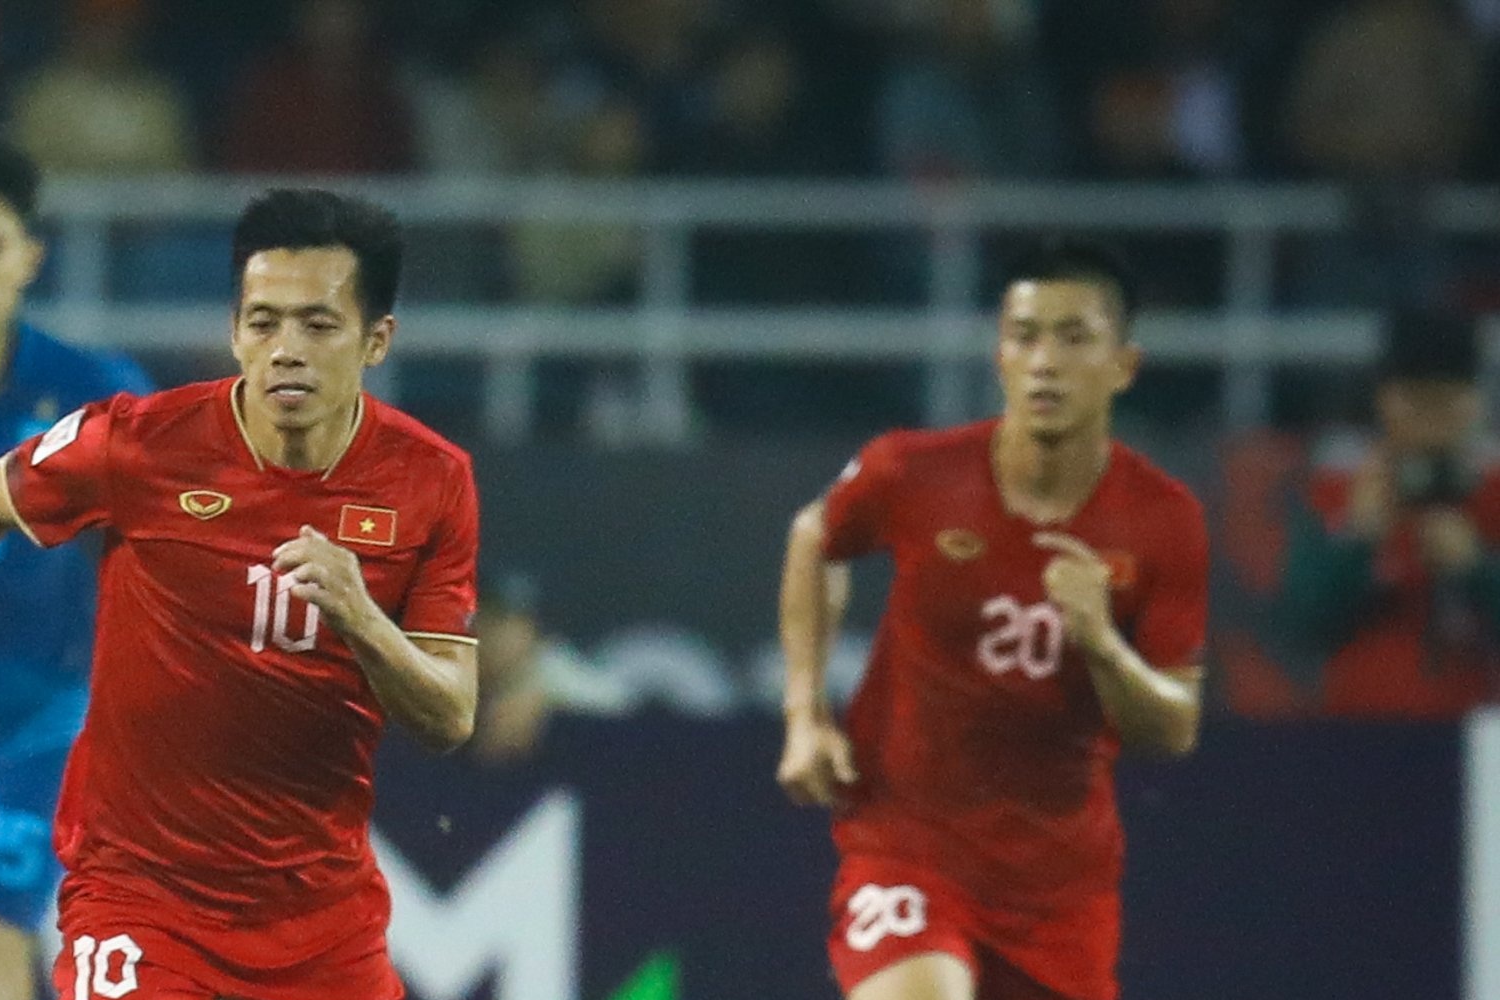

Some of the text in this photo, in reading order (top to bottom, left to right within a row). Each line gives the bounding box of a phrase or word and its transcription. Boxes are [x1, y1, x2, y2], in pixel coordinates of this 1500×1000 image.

[247, 564, 320, 654] 10
[976, 594, 1064, 679] 20
[846, 883, 927, 950] 20
